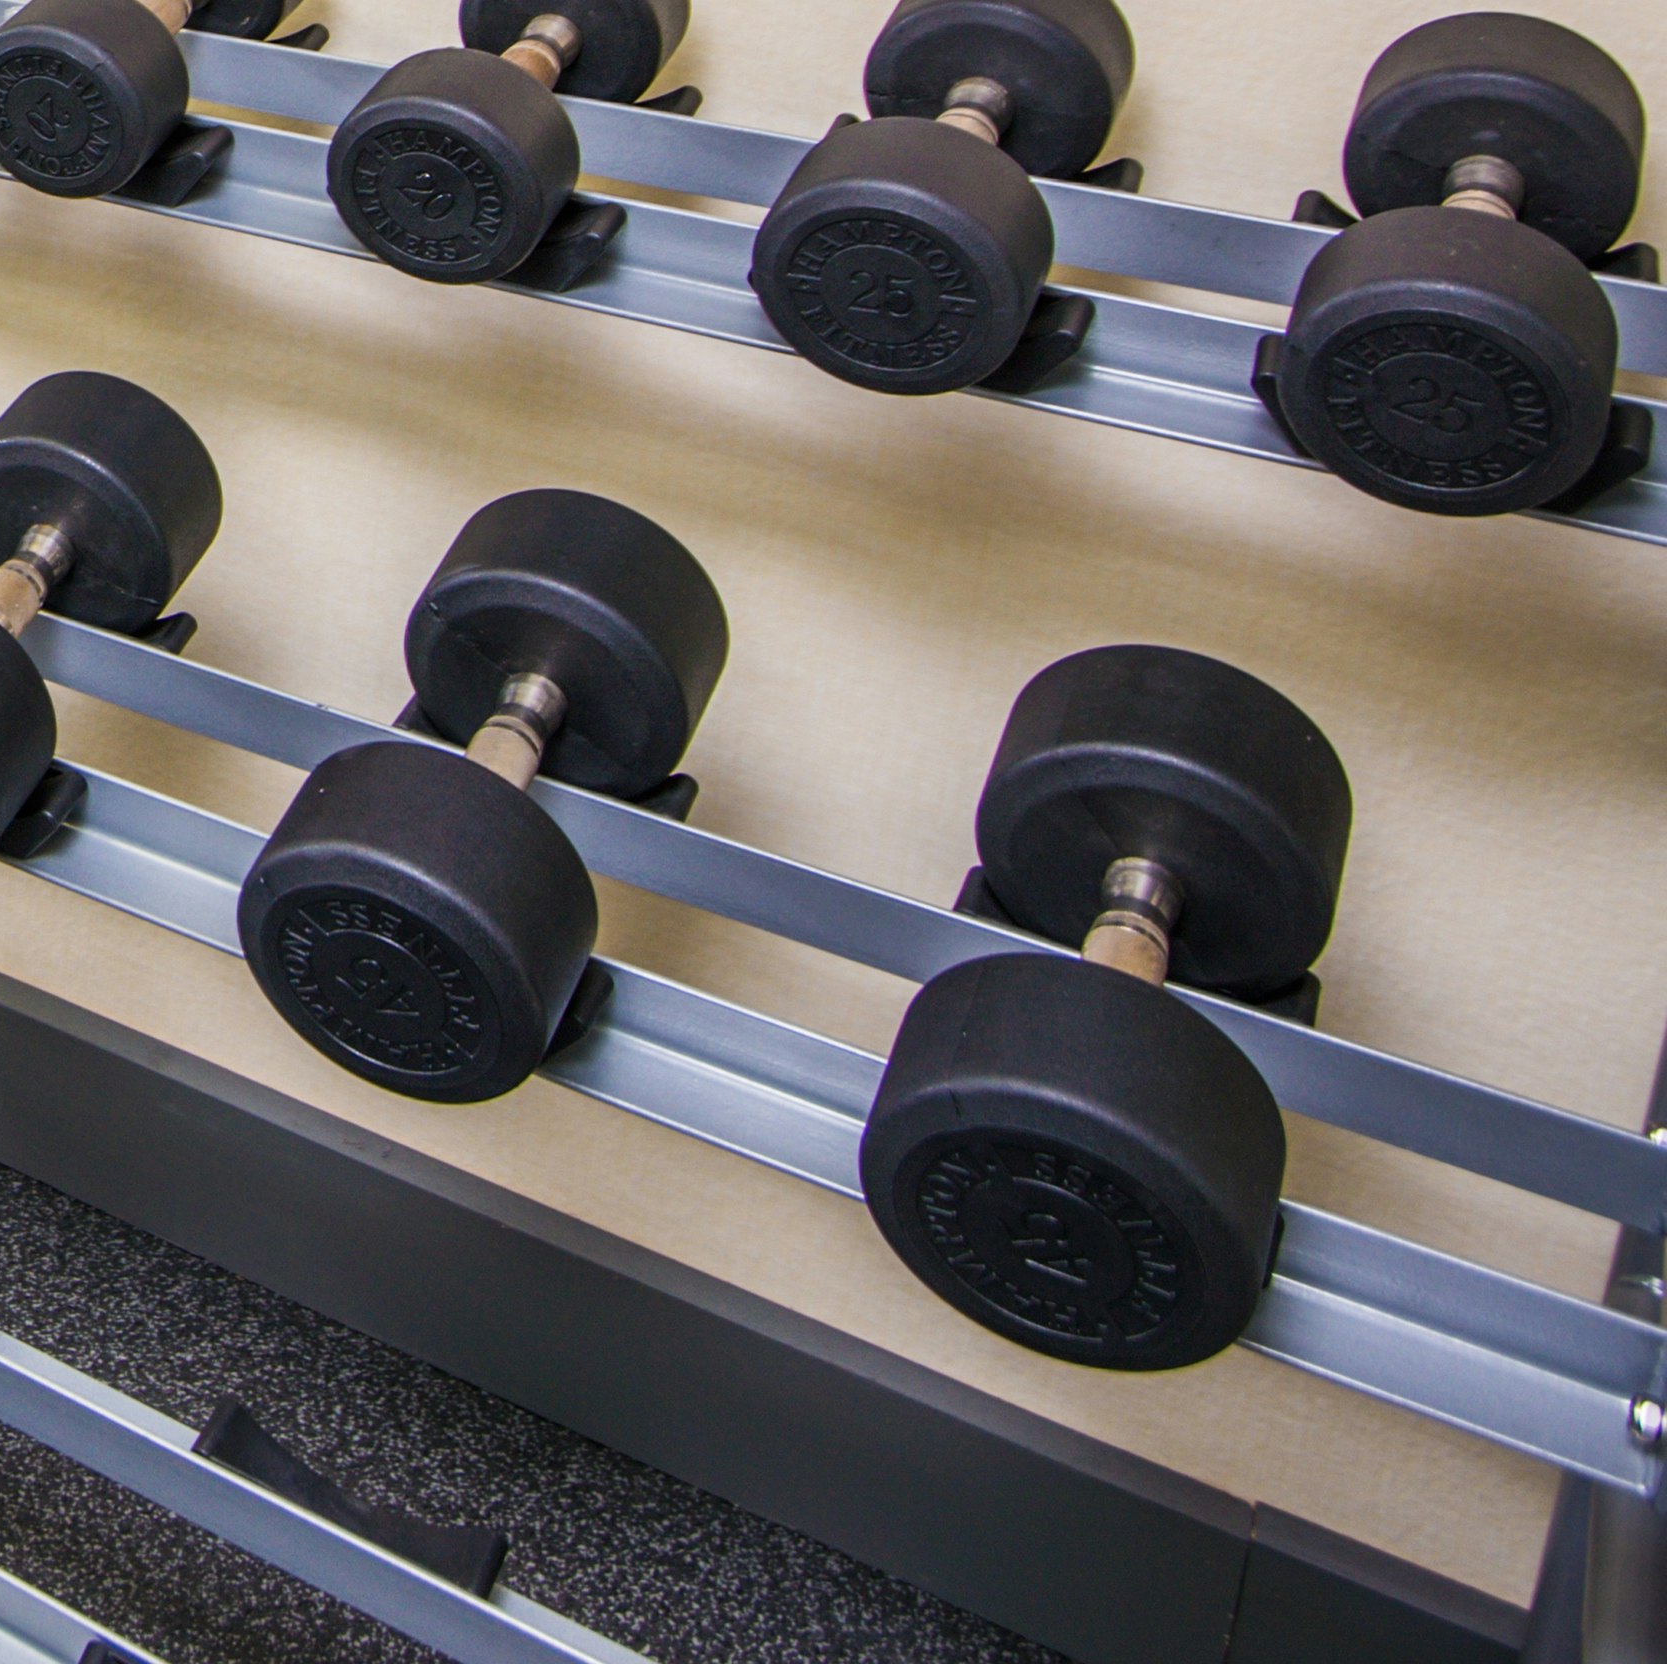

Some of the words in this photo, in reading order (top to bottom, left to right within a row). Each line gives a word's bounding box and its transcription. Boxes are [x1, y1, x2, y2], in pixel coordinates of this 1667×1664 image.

[384, 130, 502, 233] HAMPTON
[396, 172, 453, 220] 20
[795, 220, 967, 292] HAMPTON
[848, 271, 914, 318] 25
[1356, 326, 1547, 427] HAMPTON
[1389, 377, 1484, 433] 25
